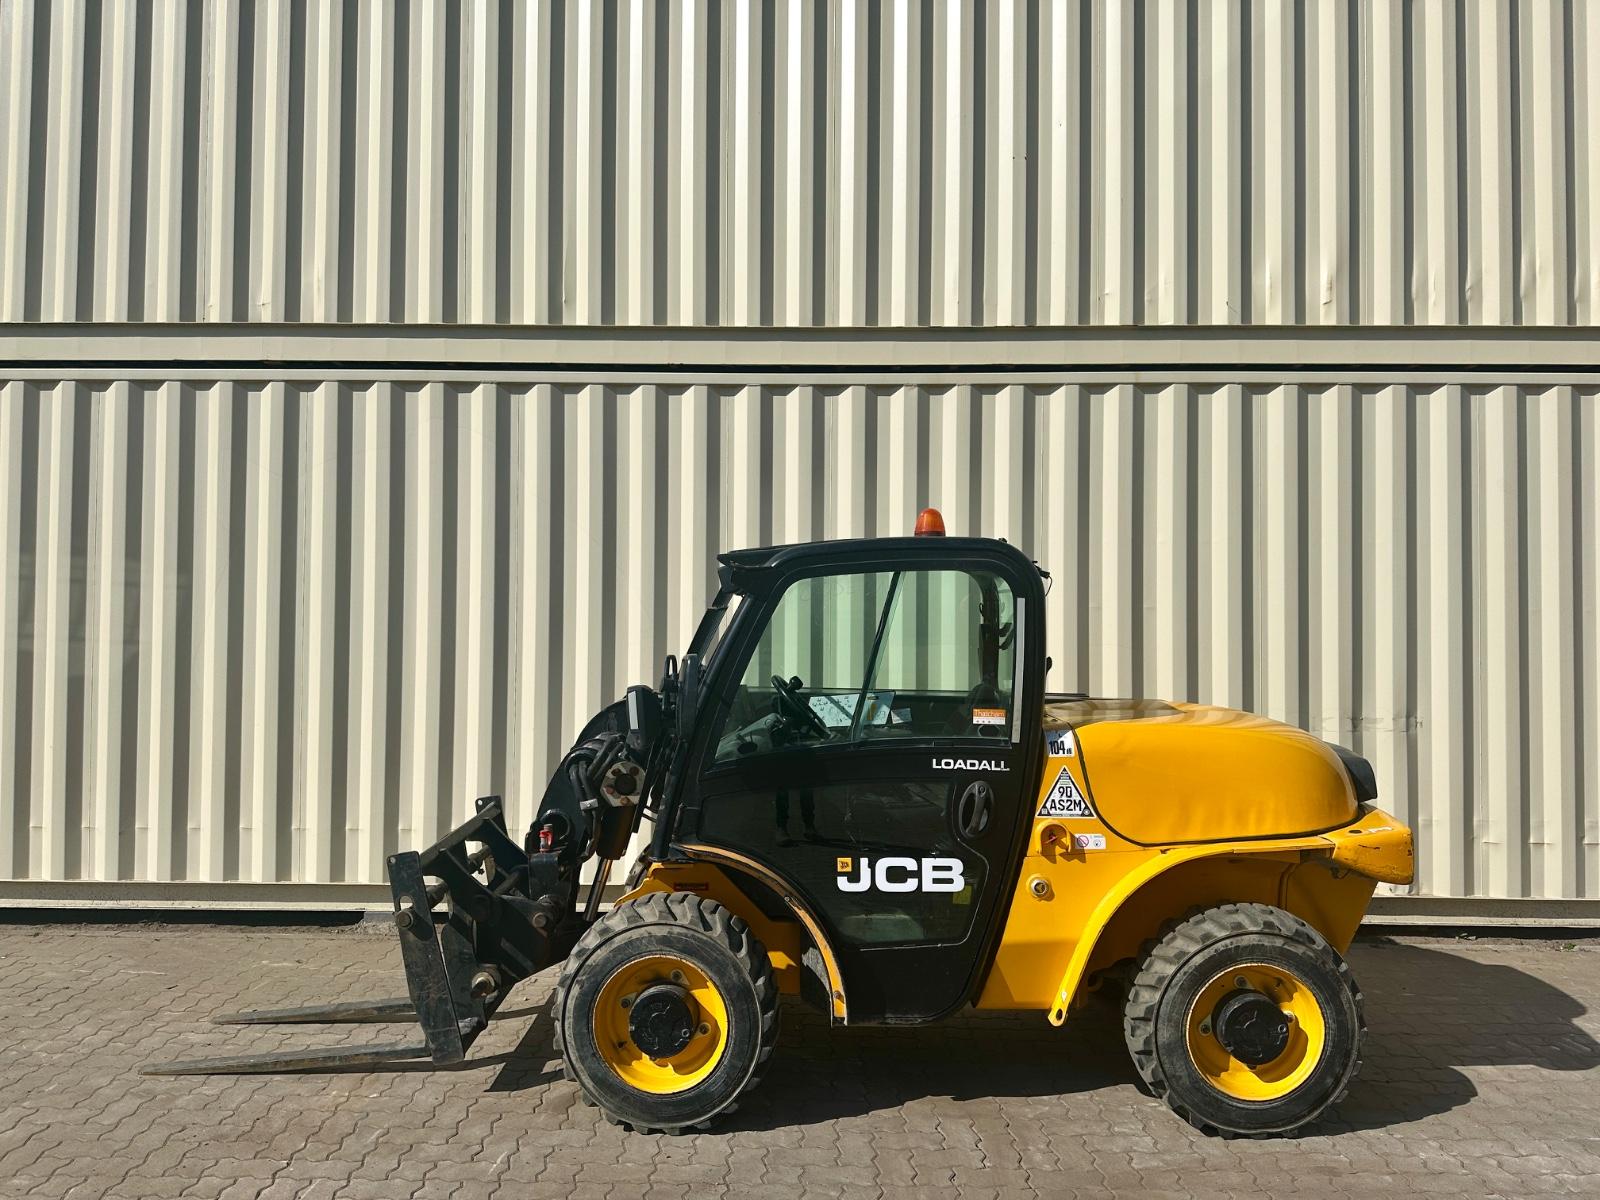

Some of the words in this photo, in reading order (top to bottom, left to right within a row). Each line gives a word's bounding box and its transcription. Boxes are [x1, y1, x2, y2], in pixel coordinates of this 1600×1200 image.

[1048, 740, 1066, 755] 104
[932, 758, 1010, 771] LOADALL
[1050, 799, 1082, 811] AS2M
[837, 857, 965, 892] JCB
